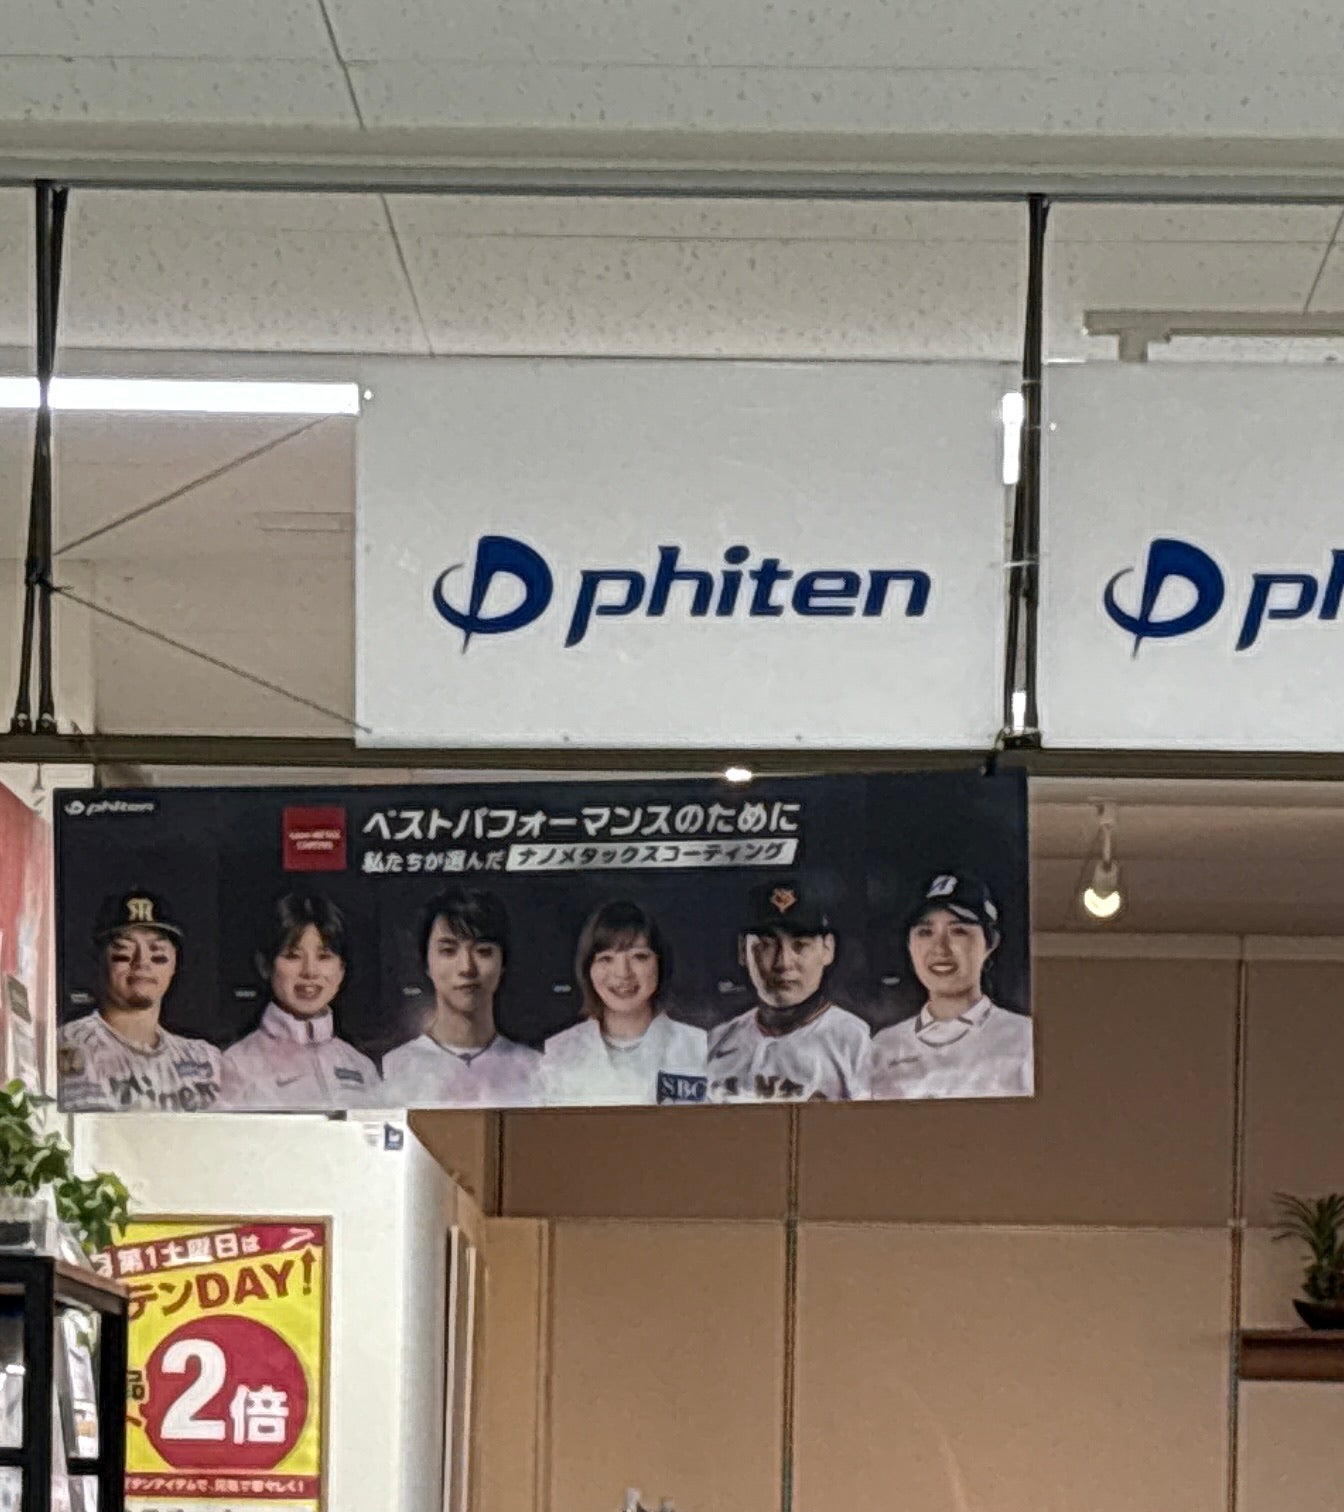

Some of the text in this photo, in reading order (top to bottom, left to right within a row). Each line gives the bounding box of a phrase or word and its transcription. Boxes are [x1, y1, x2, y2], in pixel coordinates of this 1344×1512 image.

[564, 545, 932, 648] phiten
[362, 802, 801, 840] ベストパフォーマンスのために
[362, 844, 787, 874] 私たちが選んだ ナノメタックスコーティング
[160, 1338, 289, 1444] 2倍
